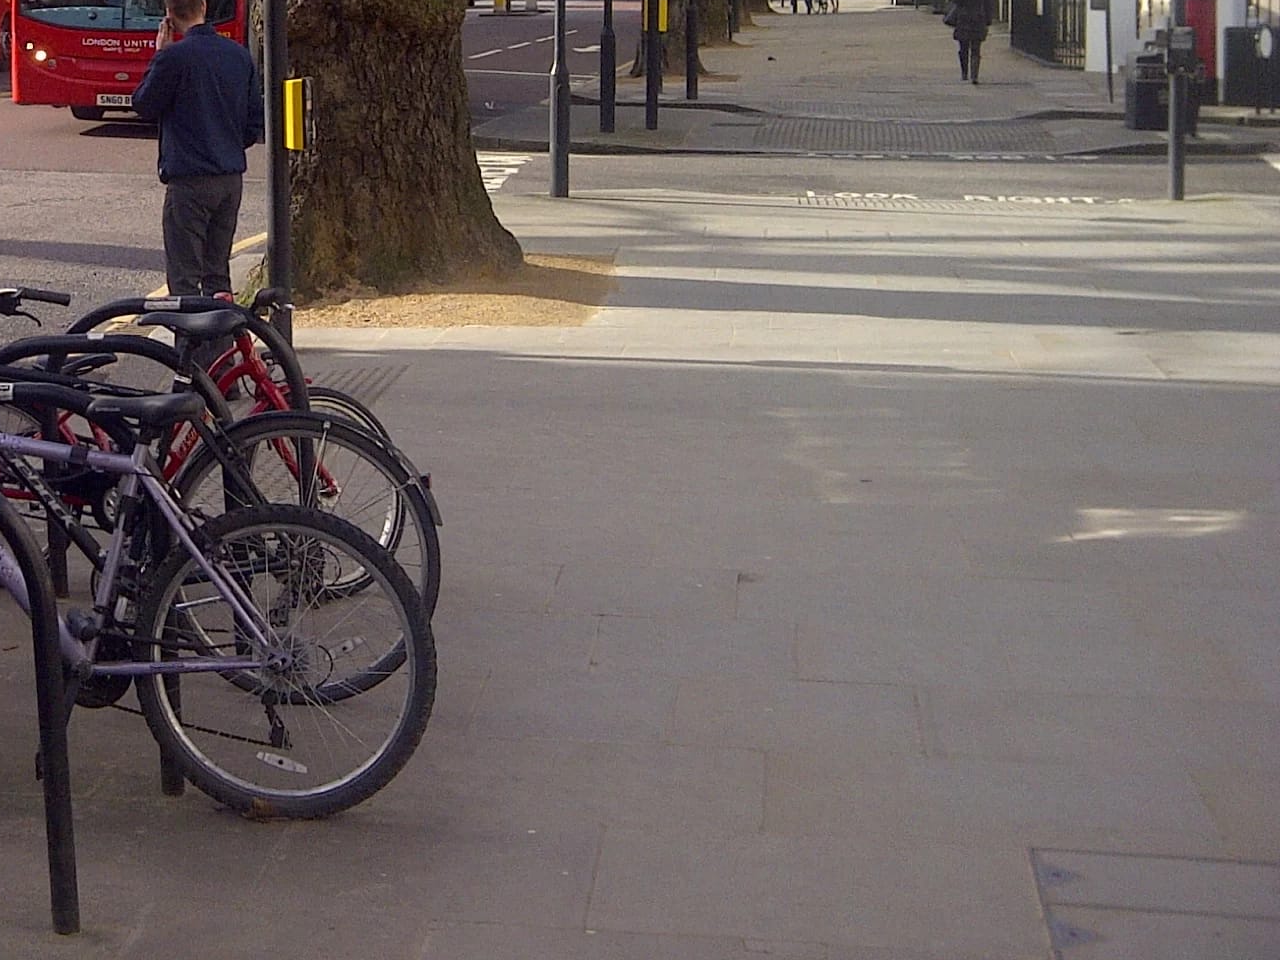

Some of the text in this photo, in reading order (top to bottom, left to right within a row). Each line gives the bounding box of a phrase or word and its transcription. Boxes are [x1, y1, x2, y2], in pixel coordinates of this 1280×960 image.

[82, 37, 157, 49] LONDON UNITE
[806, 190, 1103, 205] LOOK RIGHT
